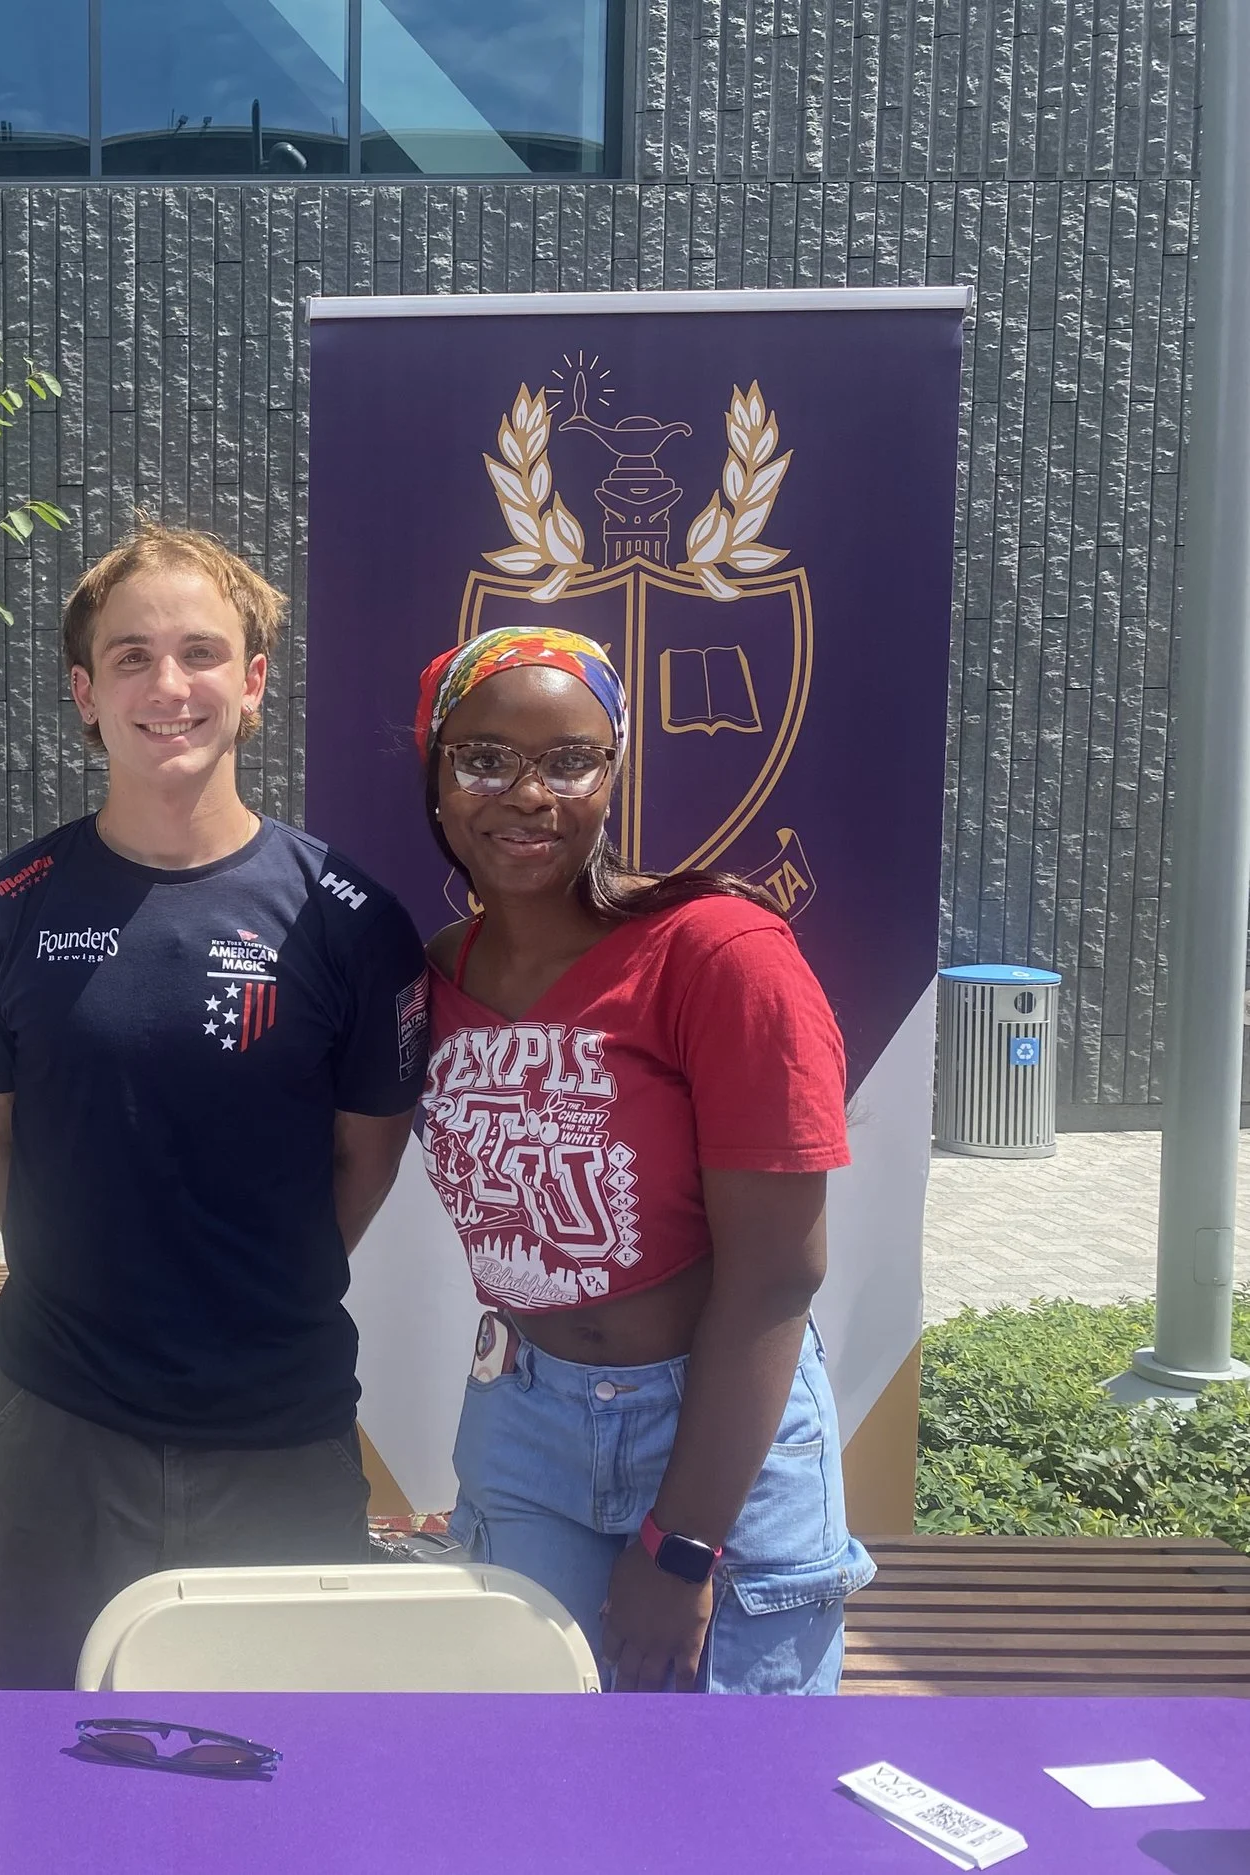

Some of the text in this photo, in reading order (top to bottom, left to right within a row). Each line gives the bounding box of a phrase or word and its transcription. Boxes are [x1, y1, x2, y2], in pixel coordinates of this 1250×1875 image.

[319, 871, 368, 910] HH
[48, 953, 104, 963] Brewing
[208, 946, 278, 962] AMERICAN
[221, 958, 266, 972] MAGIC
[421, 1023, 616, 1100] TEMPLE
[566, 1102, 581, 1110] THE
[557, 1110, 604, 1125] CHERRY
[560, 1123, 591, 1133] AND THE
[561, 1131, 603, 1146] WHITE
[585, 1274, 607, 1292] PA
